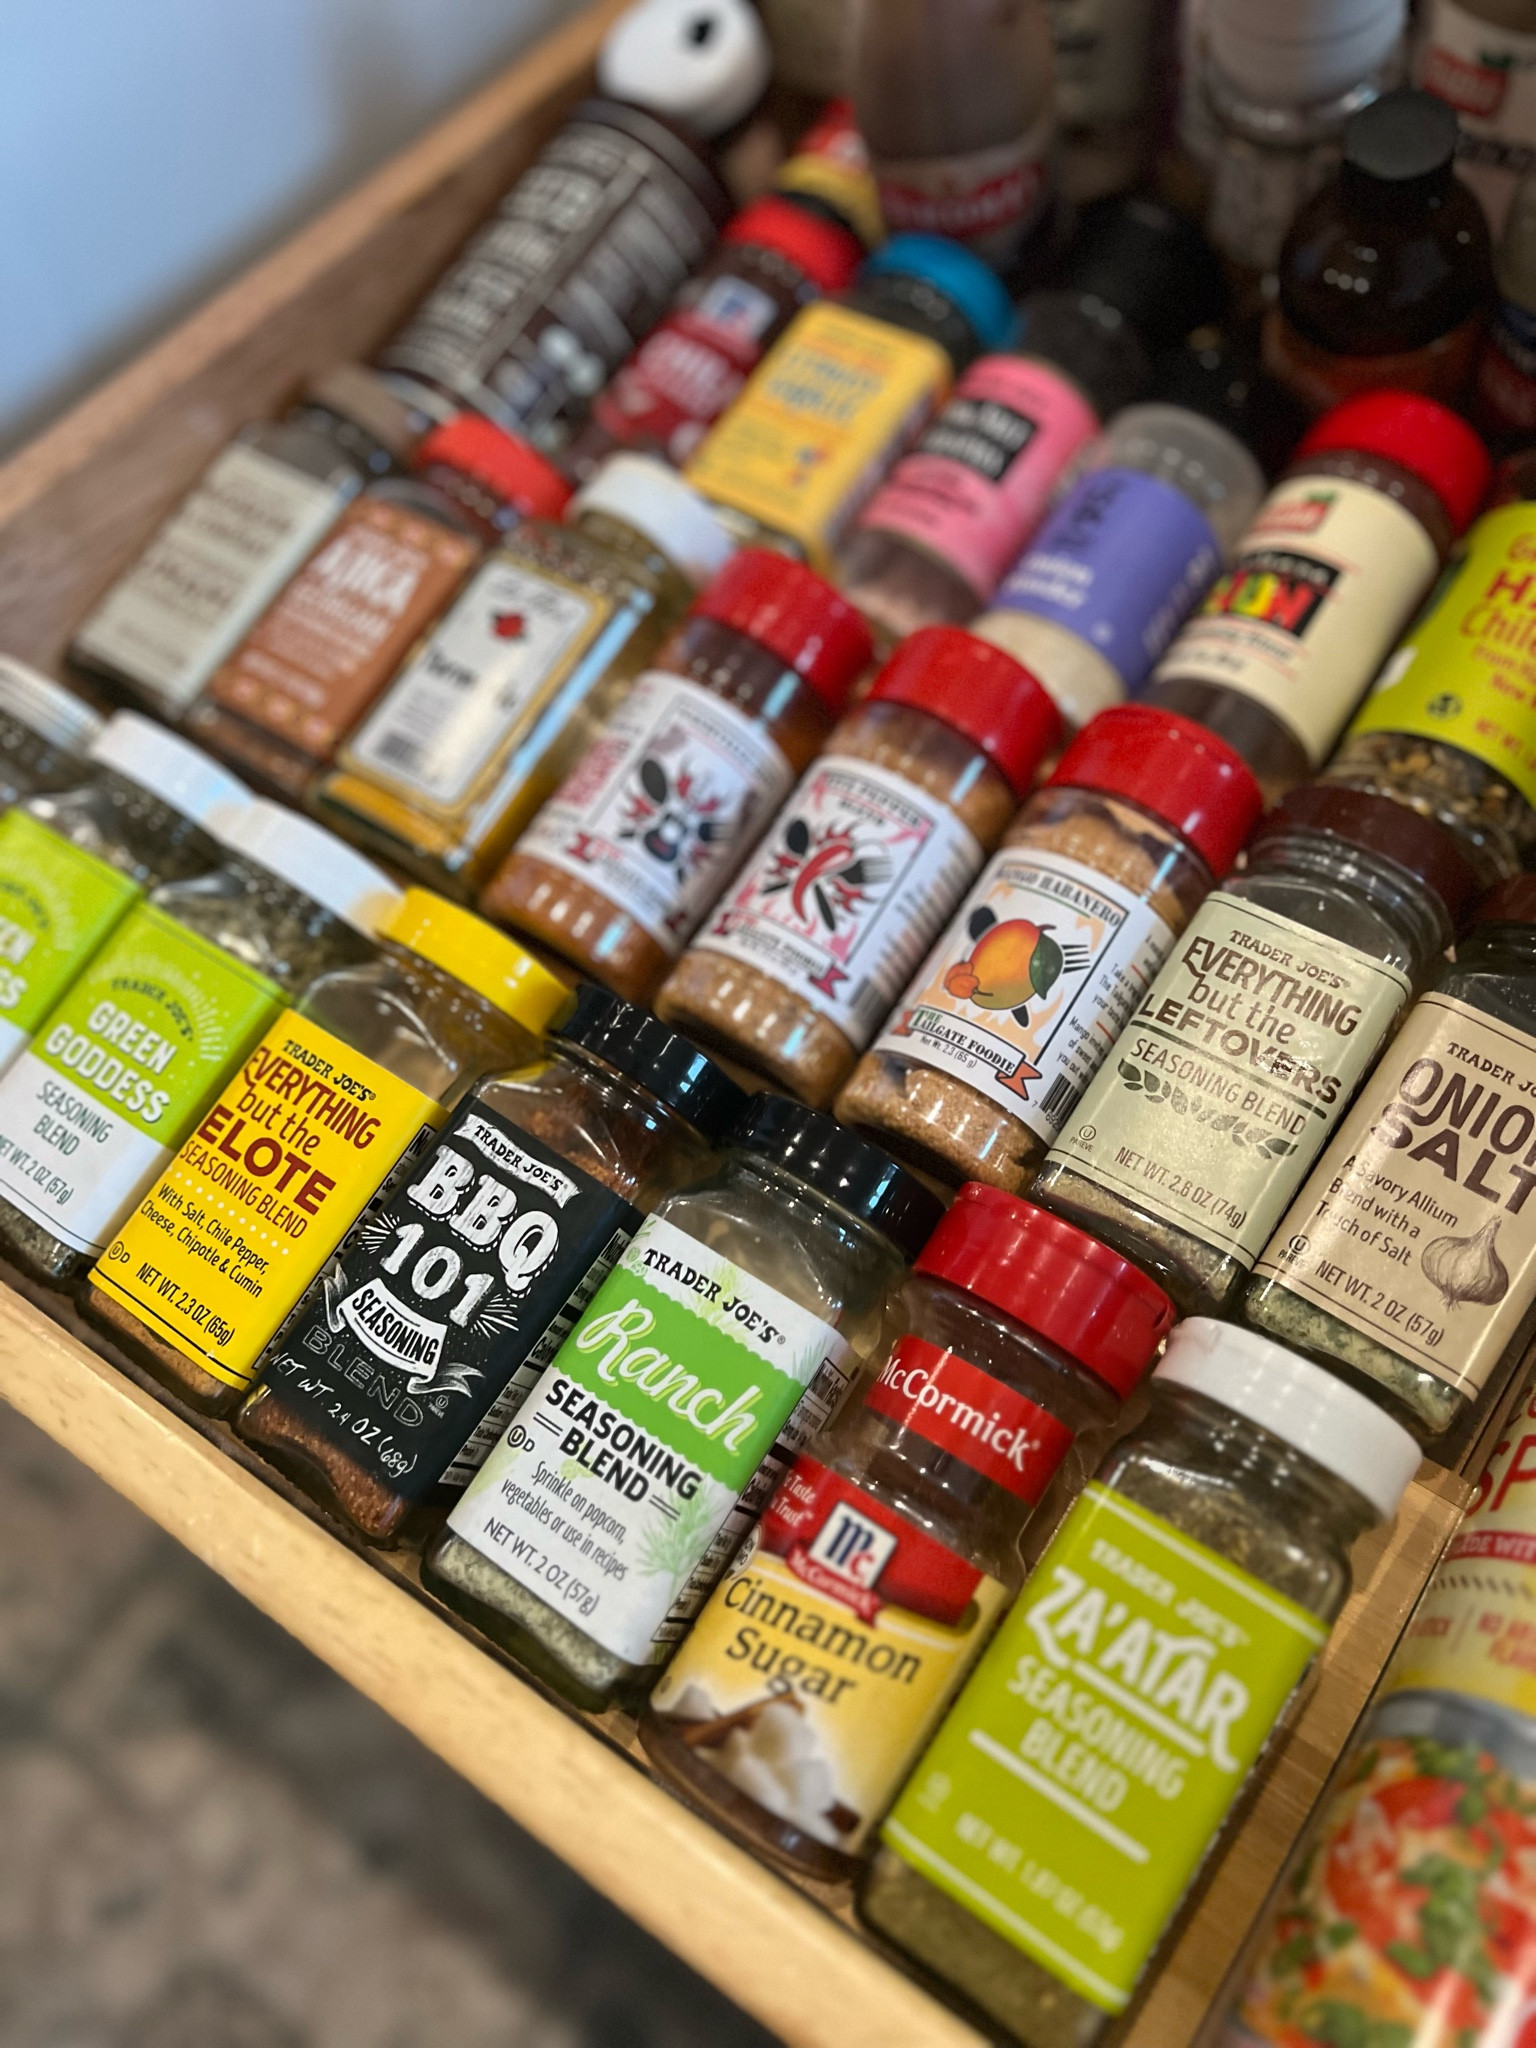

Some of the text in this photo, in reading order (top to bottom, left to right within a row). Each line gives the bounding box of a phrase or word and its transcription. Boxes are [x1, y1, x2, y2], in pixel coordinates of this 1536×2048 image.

[1039, 876, 1122, 926] HABANERO
[1182, 936, 1361, 1036] EVERYTHING
[1229, 930, 1294, 966] TRADER
[87, 1000, 177, 1075] GREEN
[1069, 1016, 1090, 1040] Mango
[1138, 995, 1342, 1104] LEFTOVERS
[1187, 978, 1296, 1044] but the
[45, 1023, 170, 1124] GODDESS
[243, 1047, 381, 1150] EVERYTHING
[284, 1040, 334, 1079] TRADER
[966, 1039, 1015, 1074] FOODIE
[1057, 1051, 1070, 1069] you
[1131, 1039, 1306, 1136] SEASONING BLEND
[1447, 1042, 1515, 1086] TRADER
[34, 1115, 80, 1156] BLEND
[37, 1080, 113, 1144] SEASONING
[237, 1086, 321, 1156] but the
[25, 1160, 35, 1177] 2
[32, 1163, 52, 1188] OZ
[46, 1175, 74, 1206] (57g)
[180, 1141, 308, 1239] SEASONING BLEND
[197, 1103, 336, 1216] ELOTE
[474, 1126, 564, 1191] TRADER JOE'S
[1115, 1146, 1139, 1170] NET
[1142, 1161, 1169, 1185] WT.
[1188, 1185, 1213, 1209] OZ
[1210, 1198, 1246, 1230] (74g)
[1343, 1156, 1459, 1228] A Savory Allium
[1371, 1102, 1536, 1216] SALT
[141, 1200, 263, 1298] Cheese, Chipotle & Cumin
[157, 1184, 269, 1275] With Salt, Chile Pepper,
[406, 1144, 561, 1298] BBQ
[1359, 1226, 1380, 1247] of
[1379, 1234, 1412, 1266] Salt
[1372, 1201, 1408, 1234] with
[1408, 1225, 1421, 1238] a
[136, 1264, 235, 1347] NET WT. 2.3 OZ (65g)
[379, 1222, 495, 1327] 101
[641, 1248, 722, 1304] TRADER
[1315, 1260, 1445, 1348] NET WT. 2 OZ (57g)
[352, 1288, 440, 1365] SEASONING
[270, 1352, 417, 1478] NET WT 2.4 OZ (68g)
[302, 1324, 424, 1429] BLEND
[576, 1298, 761, 1457] Ranch
[545, 1378, 703, 1501] SEASONING
[558, 1427, 650, 1503] BLEND
[501, 1477, 629, 1582] vegetables or use in recipes
[531, 1461, 627, 1545] Sprinkle on popcorn,
[483, 1517, 601, 1618] NET WT. 2 OZ (57g)
[723, 1573, 923, 1685] Cinnamon
[725, 1627, 857, 1704] Sugar
[1025, 1564, 1251, 1773] ZA'ATAR
[1006, 1655, 1191, 1801] SEASONING
[1019, 1717, 1130, 1814] BLEND
